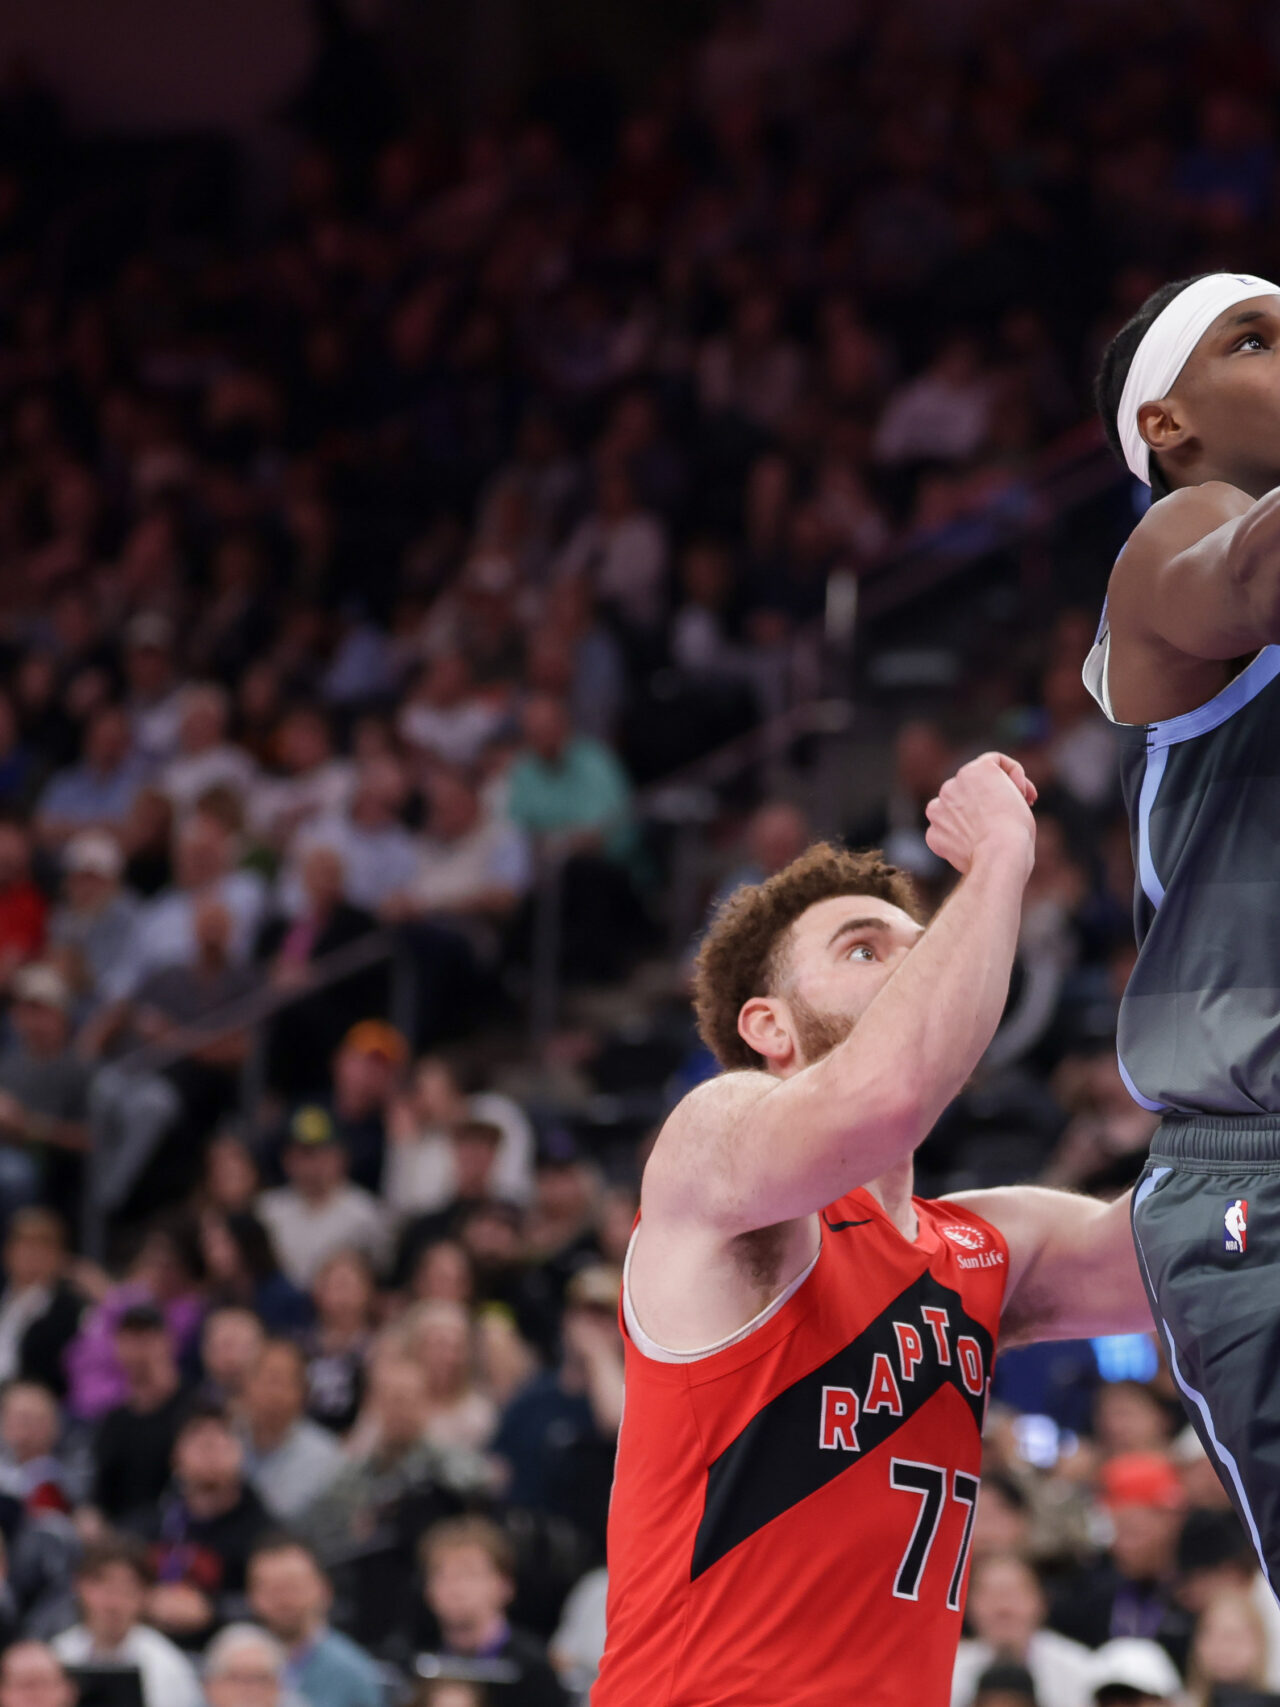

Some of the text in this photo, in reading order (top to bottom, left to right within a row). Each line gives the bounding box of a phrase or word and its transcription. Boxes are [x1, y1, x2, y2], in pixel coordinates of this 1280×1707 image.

[956, 1249, 1004, 1269] Sun Life
[1225, 1240, 1238, 1251] NBA
[819, 1305, 991, 1452] RAPTO
[889, 1457, 981, 1612] 77
